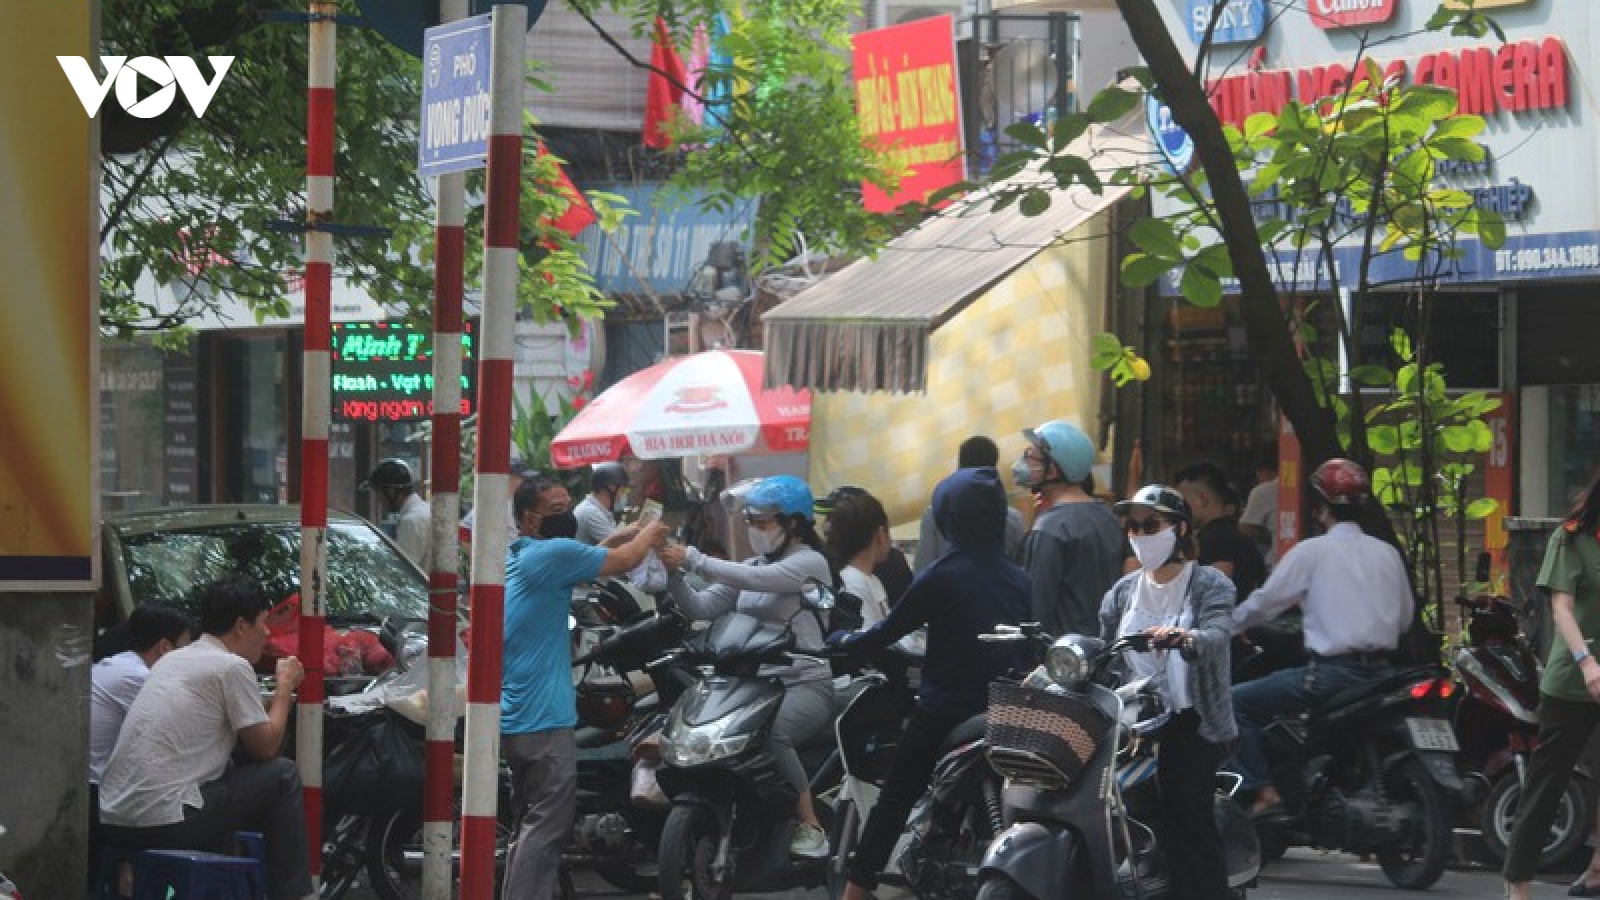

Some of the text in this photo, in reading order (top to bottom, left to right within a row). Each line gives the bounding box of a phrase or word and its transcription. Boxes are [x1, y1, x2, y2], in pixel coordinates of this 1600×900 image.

[453, 41, 477, 78] PHỐ
[1414, 36, 1566, 115] CAMERA
[426, 97, 461, 158] VỌNG
[333, 373, 378, 391] Flash
